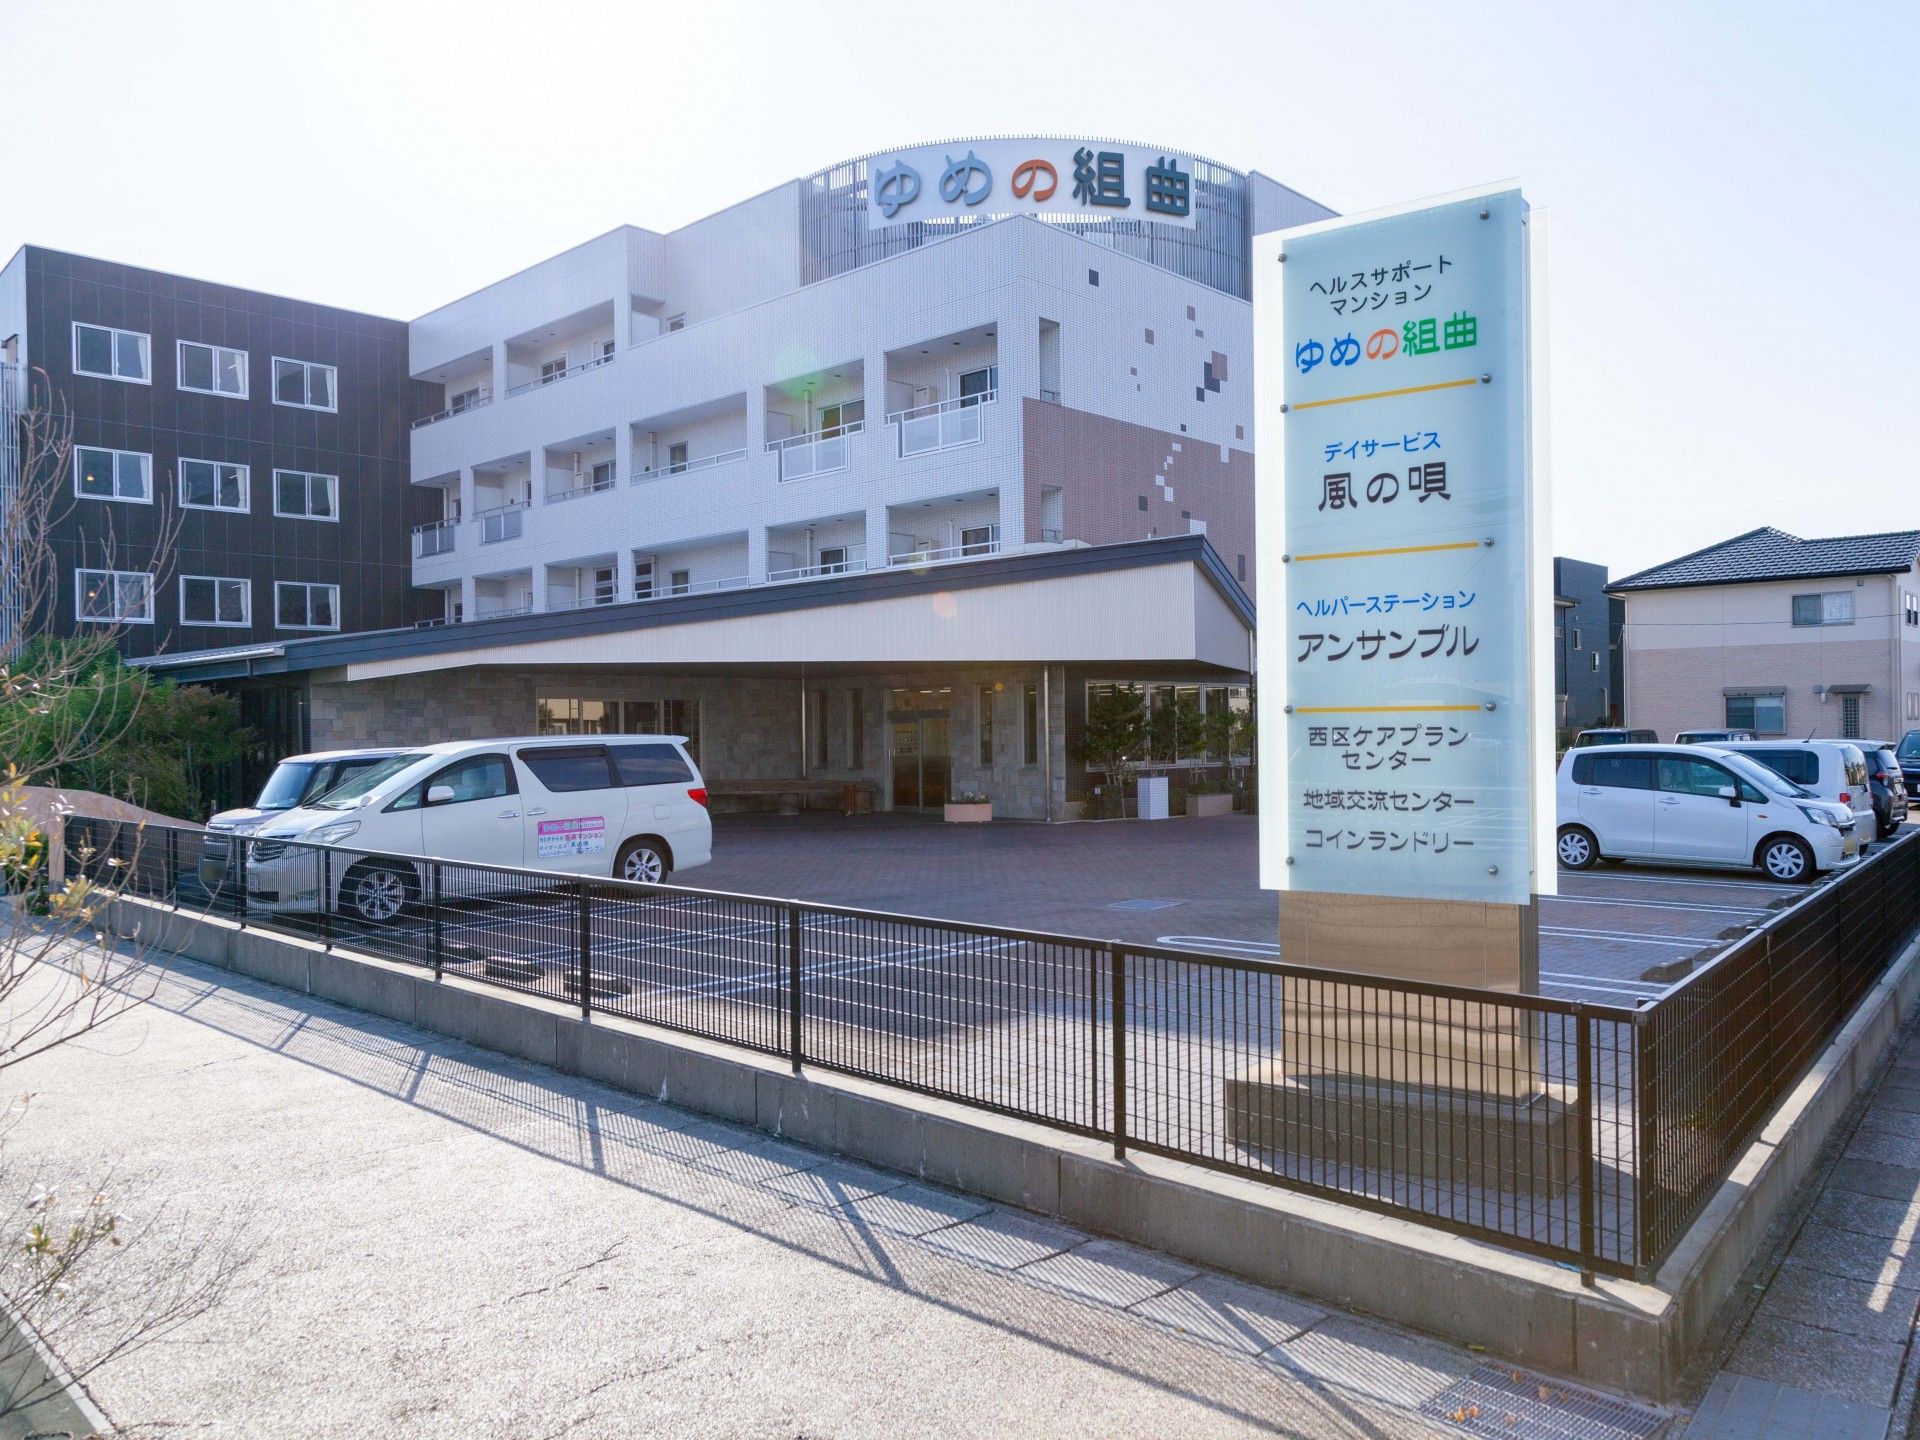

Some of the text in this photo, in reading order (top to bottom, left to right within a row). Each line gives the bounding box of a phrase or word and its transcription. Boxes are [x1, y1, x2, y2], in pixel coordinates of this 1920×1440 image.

[874, 146, 1189, 219] ゆめの組曲
[1309, 255, 1452, 295] ヘルスサポート
[1330, 284, 1432, 315] マンション
[1295, 310, 1477, 374] ゆめの組曲
[1324, 432, 1441, 462] デイサービス
[1318, 461, 1451, 512] 風の唄
[1297, 590, 1476, 616] ヘルパーステーション
[1297, 624, 1479, 662] アンサンブル
[1308, 723, 1468, 747] 西区ケアプラン
[1341, 750, 1431, 770] センター
[1303, 789, 1474, 812] 地域交流センター
[1305, 830, 1474, 853] コインランドリー
